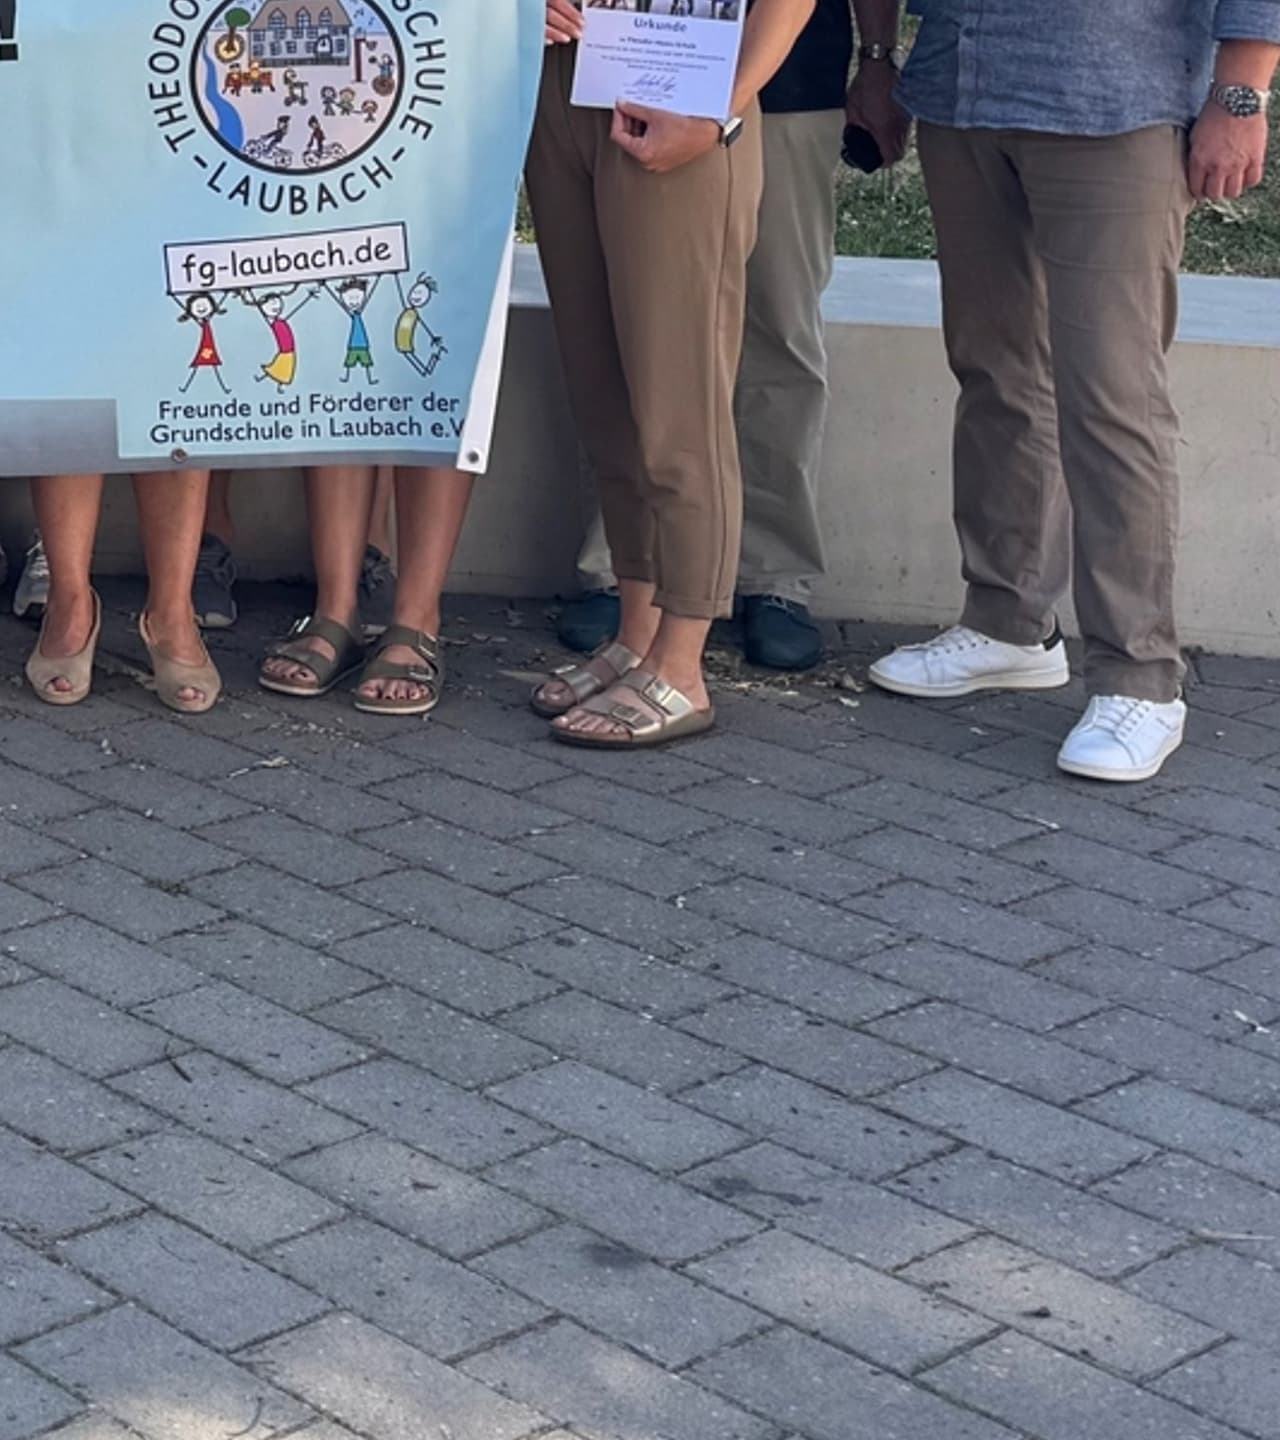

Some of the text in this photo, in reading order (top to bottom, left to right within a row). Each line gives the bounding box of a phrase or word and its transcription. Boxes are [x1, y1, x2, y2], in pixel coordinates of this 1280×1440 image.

[633, 17, 688, 33] Urkunde
[180, 236, 392, 289] fg-laubach.de
[158, 390, 461, 421] Freunde und Förderer der
[149, 420, 294, 445] Grundschule
[300, 419, 322, 439] in
[328, 415, 423, 438] Laubach
